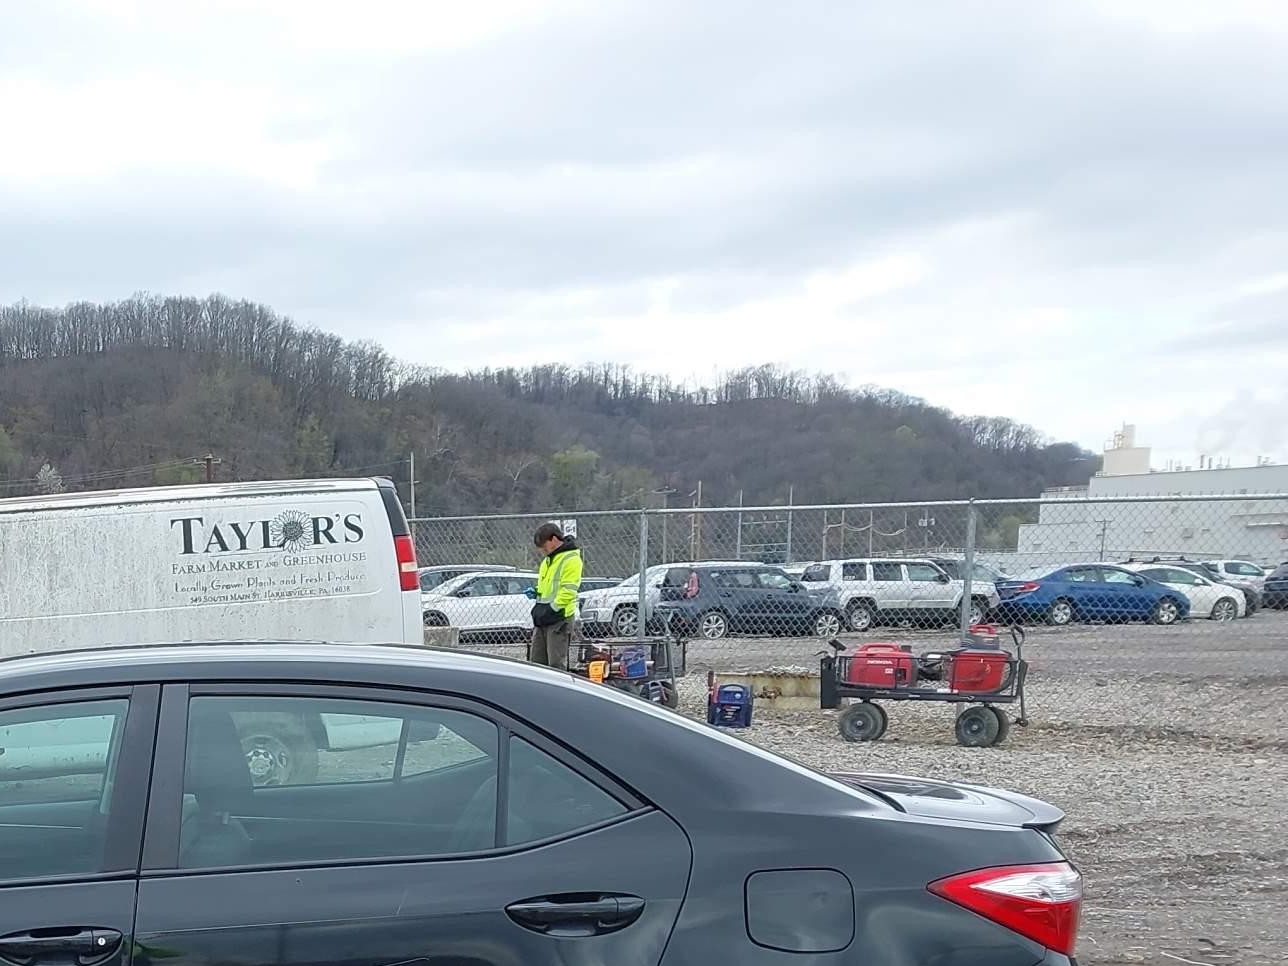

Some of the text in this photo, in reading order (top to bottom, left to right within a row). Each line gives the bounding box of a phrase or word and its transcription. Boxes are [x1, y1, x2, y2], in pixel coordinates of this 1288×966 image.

[172, 552, 367, 575] FARM MARKET AND GREENHOUSE
[175, 569, 366, 594] Locally Grown Plants and Fresh Produce
[203, 595, 229, 603] SOUTH
